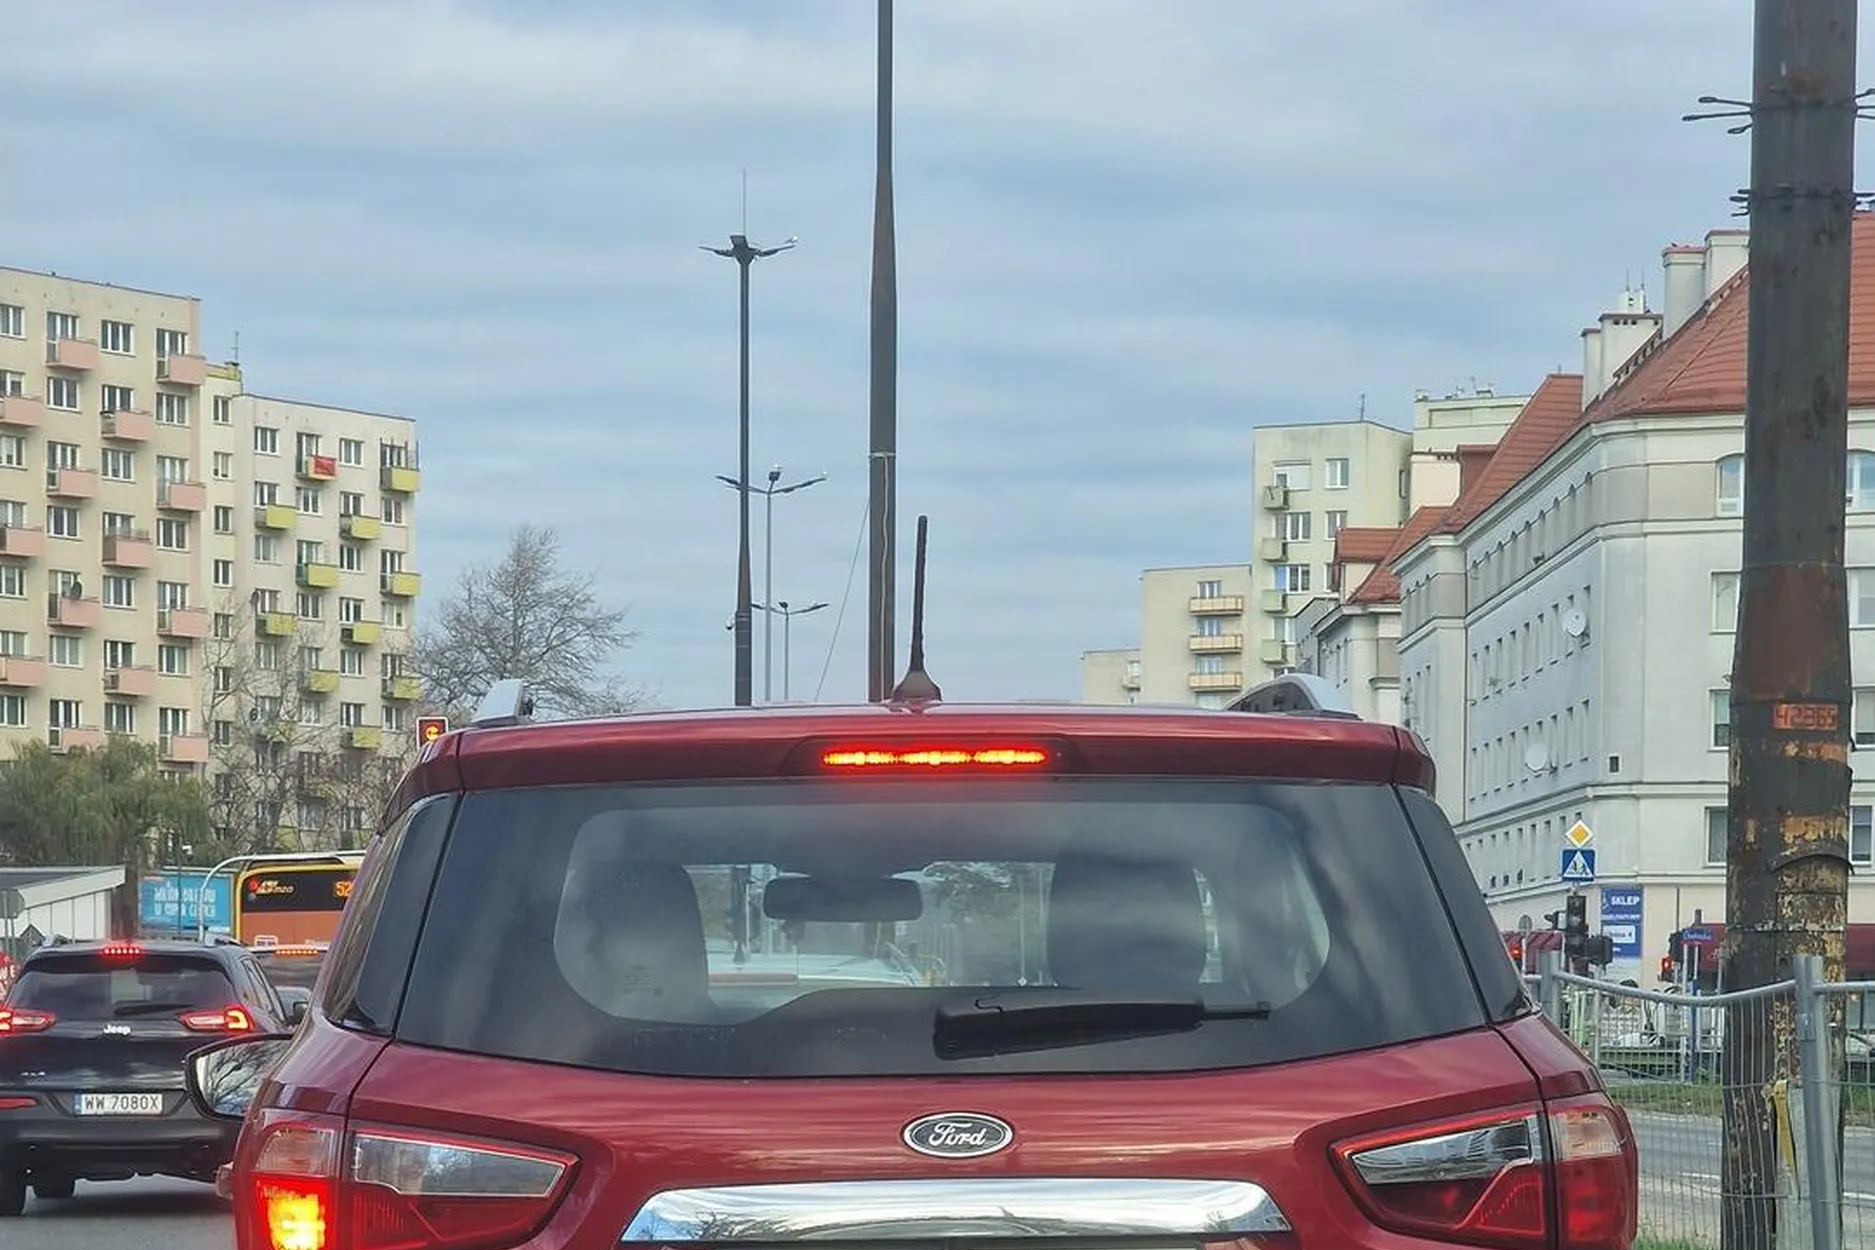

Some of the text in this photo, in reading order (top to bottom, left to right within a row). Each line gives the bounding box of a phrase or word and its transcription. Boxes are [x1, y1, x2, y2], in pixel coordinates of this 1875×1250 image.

[1610, 895, 1640, 905] SKLEP
[103, 1023, 131, 1035] Jeep
[85, 1095, 104, 1110] WW
[111, 1094, 159, 1110] 7080X
[928, 1121, 987, 1146] Ford
